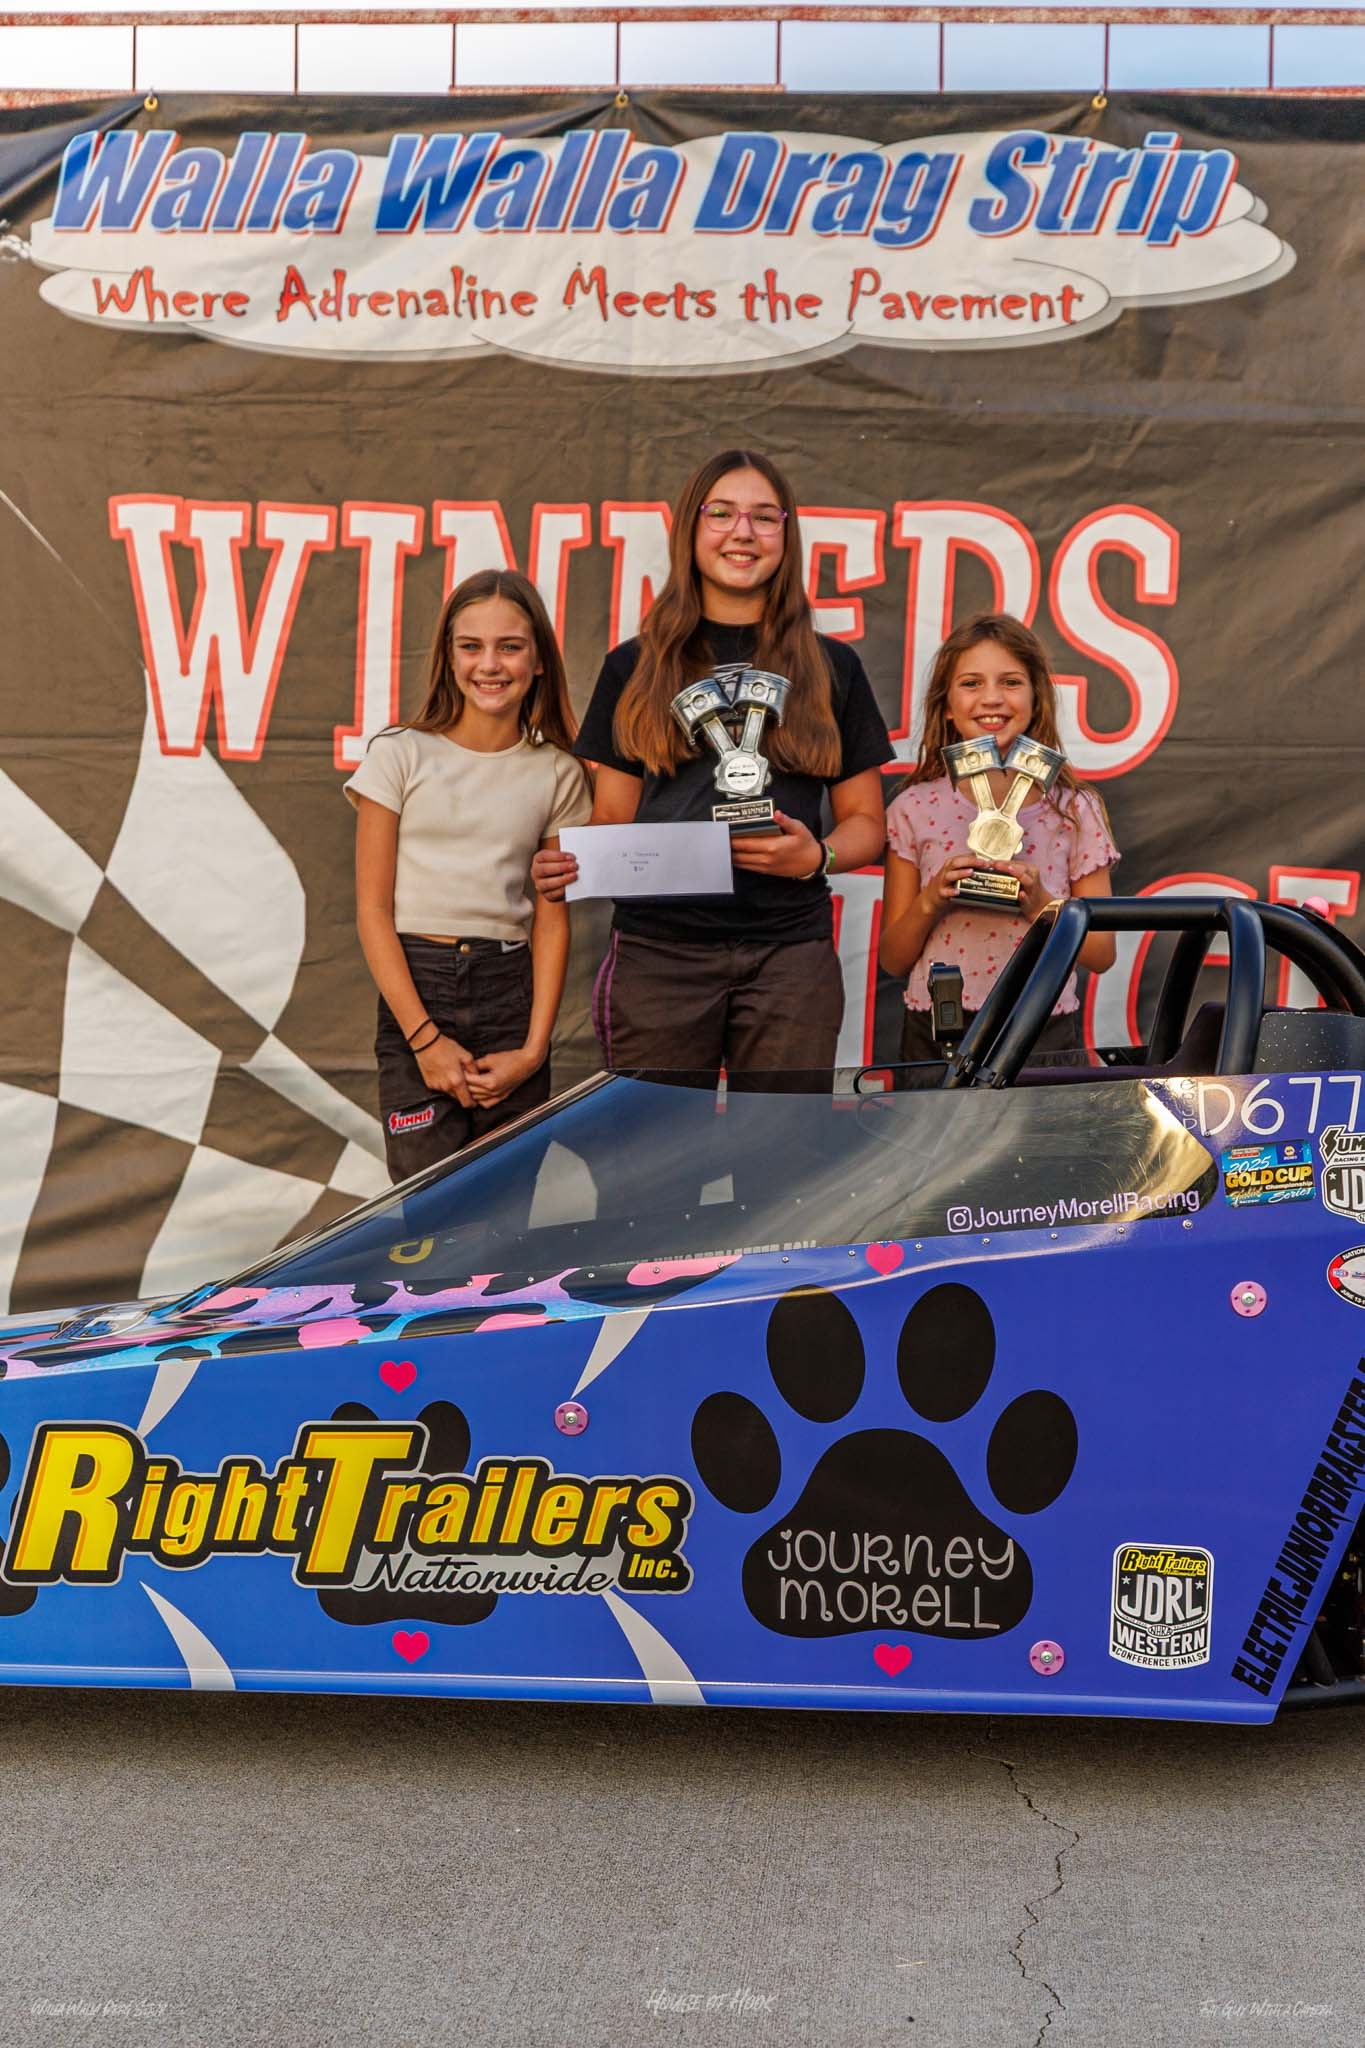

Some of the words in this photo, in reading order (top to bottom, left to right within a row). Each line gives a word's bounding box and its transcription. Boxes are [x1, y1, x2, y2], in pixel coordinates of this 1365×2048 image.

[53, 130, 362, 235] Walla
[374, 128, 687, 235] Walla
[693, 131, 964, 249] Drag
[968, 130, 1239, 247] Strip
[93, 266, 250, 322] Where
[276, 264, 538, 322] Adrenaline
[564, 262, 717, 322] Meets
[738, 268, 823, 322] the
[845, 266, 1084, 327] Pavement
[1197, 1075, 1362, 1137] D677
[1226, 1169, 1274, 1189] GOLD
[1275, 1165, 1313, 1183] CUP
[1227, 1155, 1272, 1176] 2025
[1265, 1180, 1313, 1191] Championship
[1267, 1187, 1312, 1204] Series
[973, 1190, 1200, 1229] JourneyMorellRacing
[353, 1552, 614, 1594] Nationwide
[628, 1552, 679, 1580] Inc.
[1120, 1574, 1203, 1624] JDRL
[1115, 1620, 1206, 1656] WESTERN
[1115, 1646, 1170, 1667] CONFERENCE
[1172, 1651, 1204, 1667] FINALS
